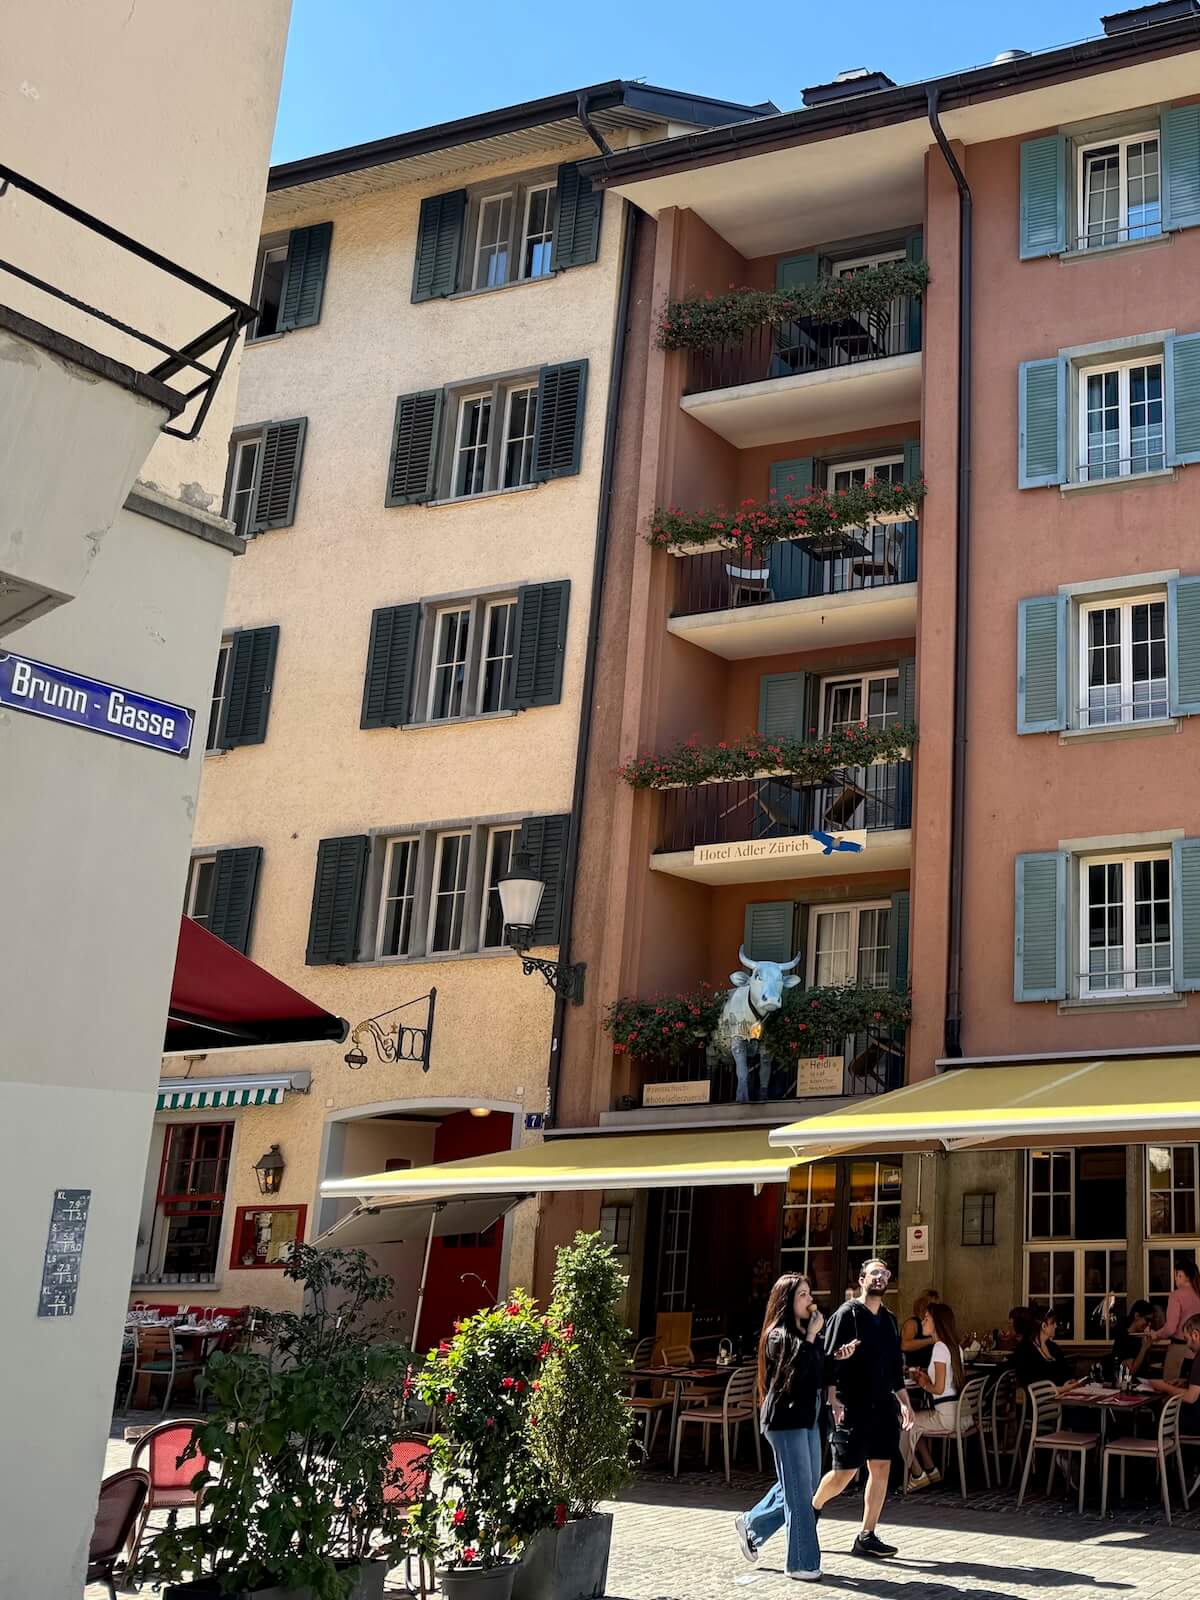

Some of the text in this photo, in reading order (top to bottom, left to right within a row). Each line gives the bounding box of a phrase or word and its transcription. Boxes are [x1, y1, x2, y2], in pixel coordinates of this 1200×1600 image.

[11, 661, 88, 714] Brunn
[107, 691, 175, 739] Gasse
[699, 839, 810, 862] Hotel Adler Zürich
[810, 1059, 832, 1070] Heidi
[530, 1115, 537, 1127] 7
